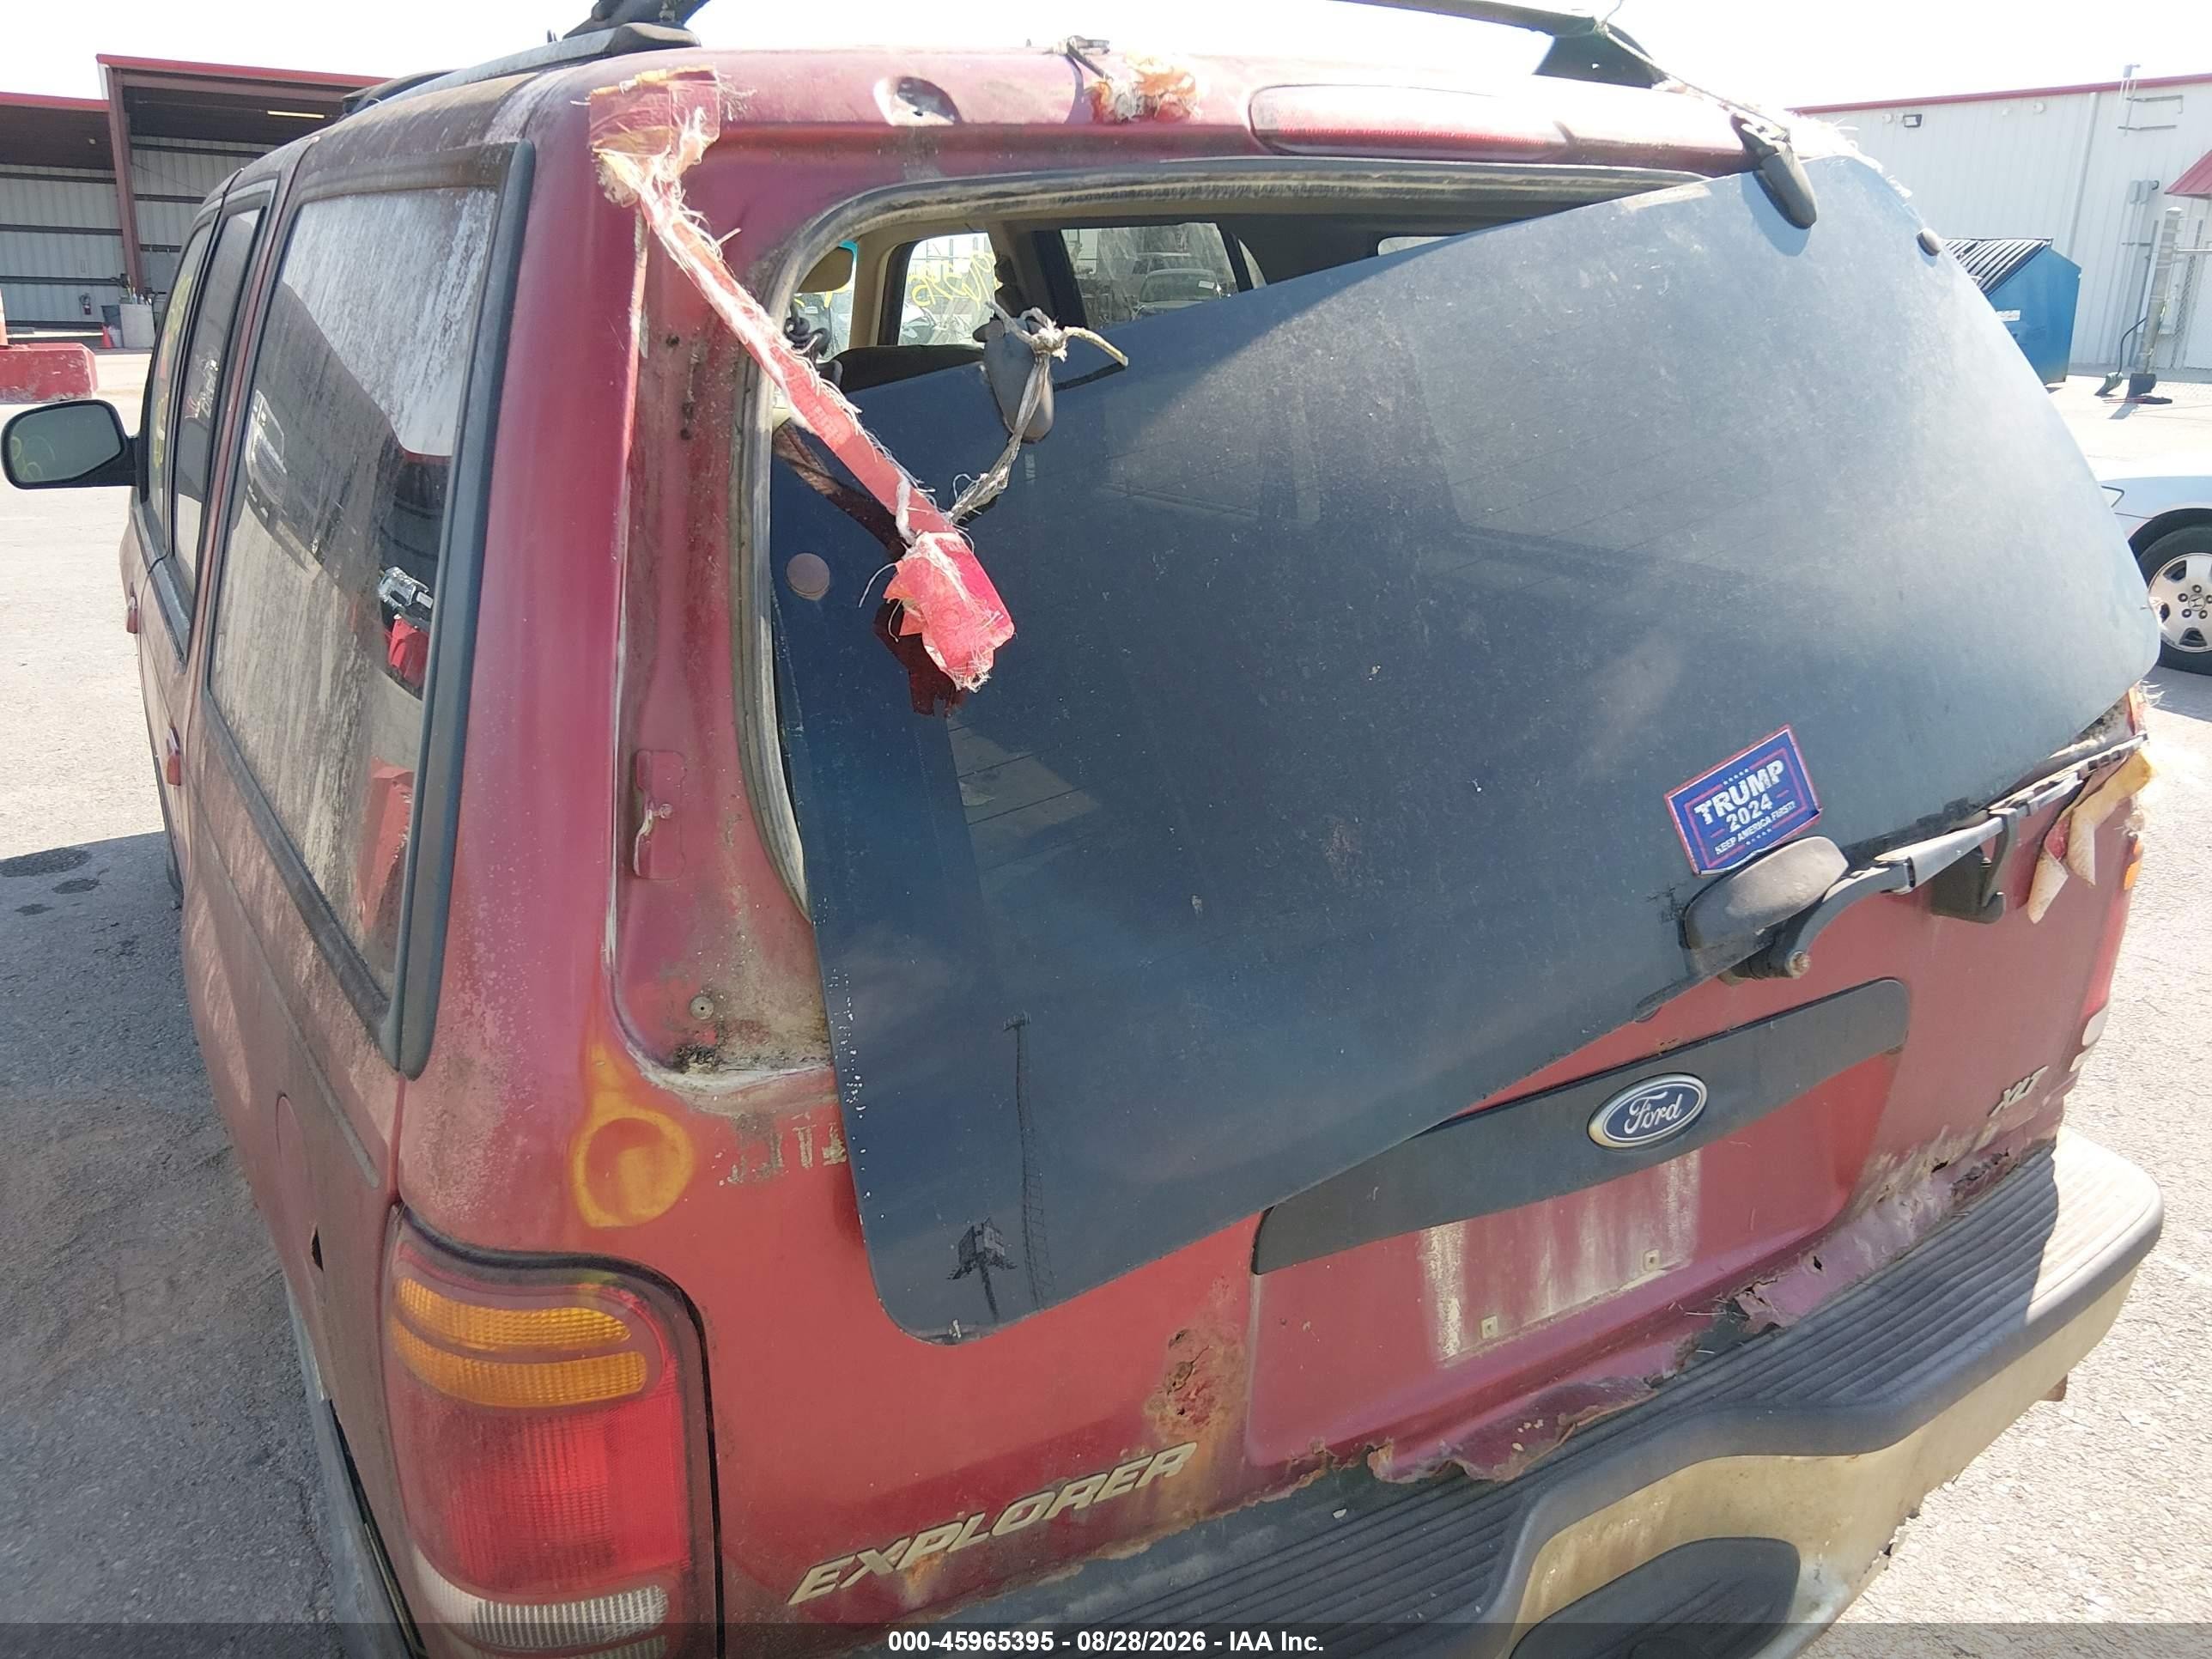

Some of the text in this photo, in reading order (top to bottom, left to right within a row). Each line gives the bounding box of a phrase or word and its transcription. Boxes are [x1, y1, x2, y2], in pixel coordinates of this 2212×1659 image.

[1693, 759, 1784, 825] TRUMP
[1726, 793, 1772, 833] 2024
[1714, 836, 1737, 855] KEEP
[1737, 816, 1773, 842] AMERICA
[1623, 1091, 1683, 1135] Ford
[1987, 1064, 2050, 1118] XLT
[786, 1441, 1198, 1607] EXPLORER
